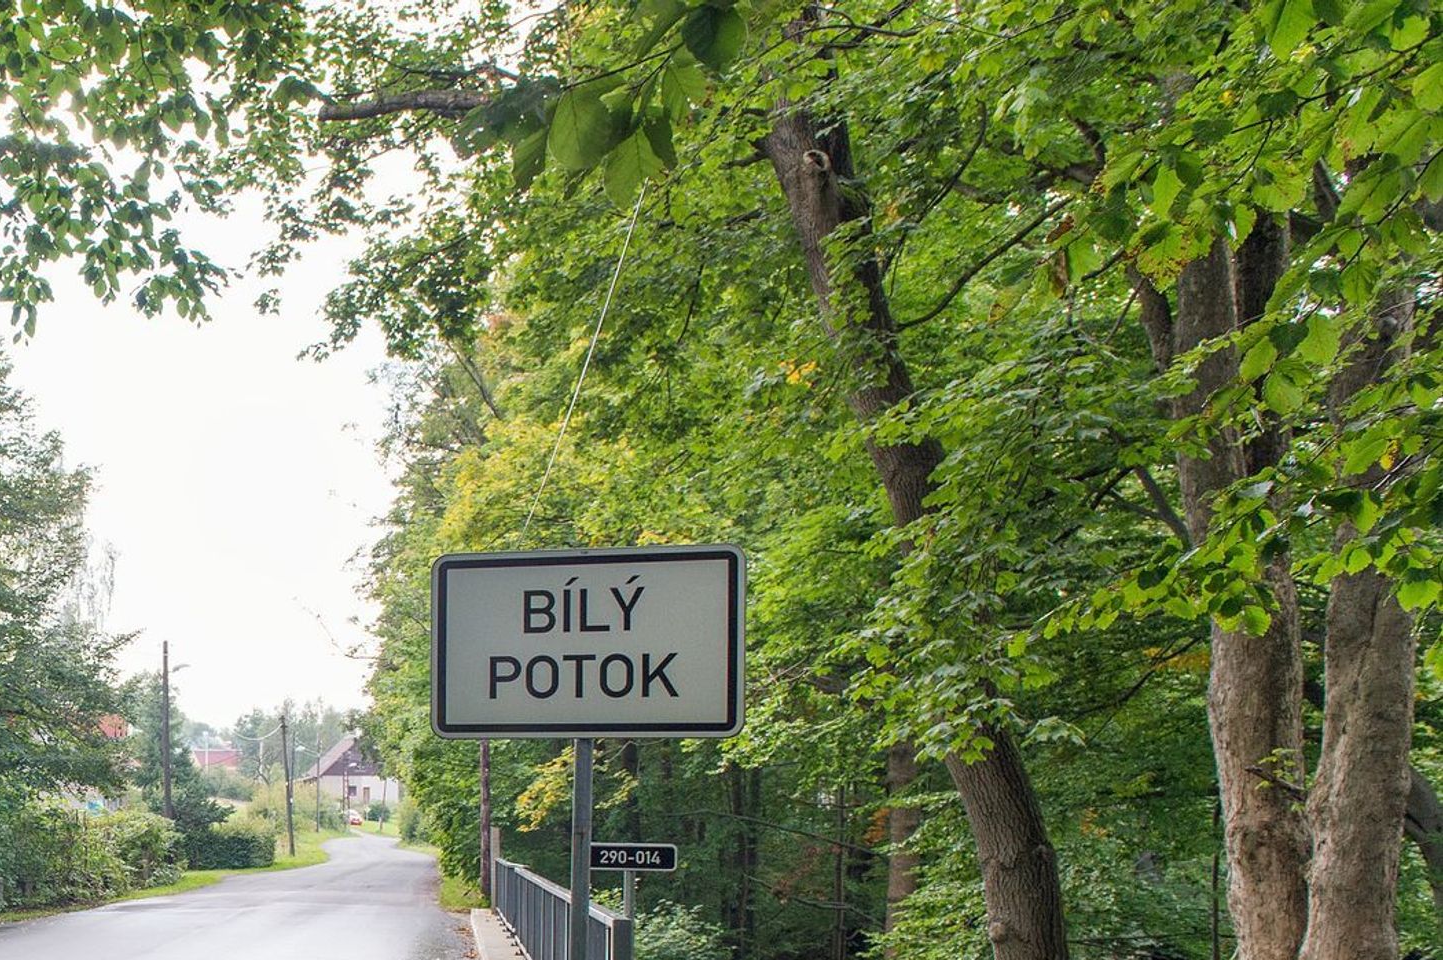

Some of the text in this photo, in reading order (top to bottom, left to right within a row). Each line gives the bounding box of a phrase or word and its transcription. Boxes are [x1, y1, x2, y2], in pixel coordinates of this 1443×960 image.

[523, 575, 645, 634] BÍLÝ
[489, 652, 679, 699] POTOK
[599, 850, 661, 865] 290-014
